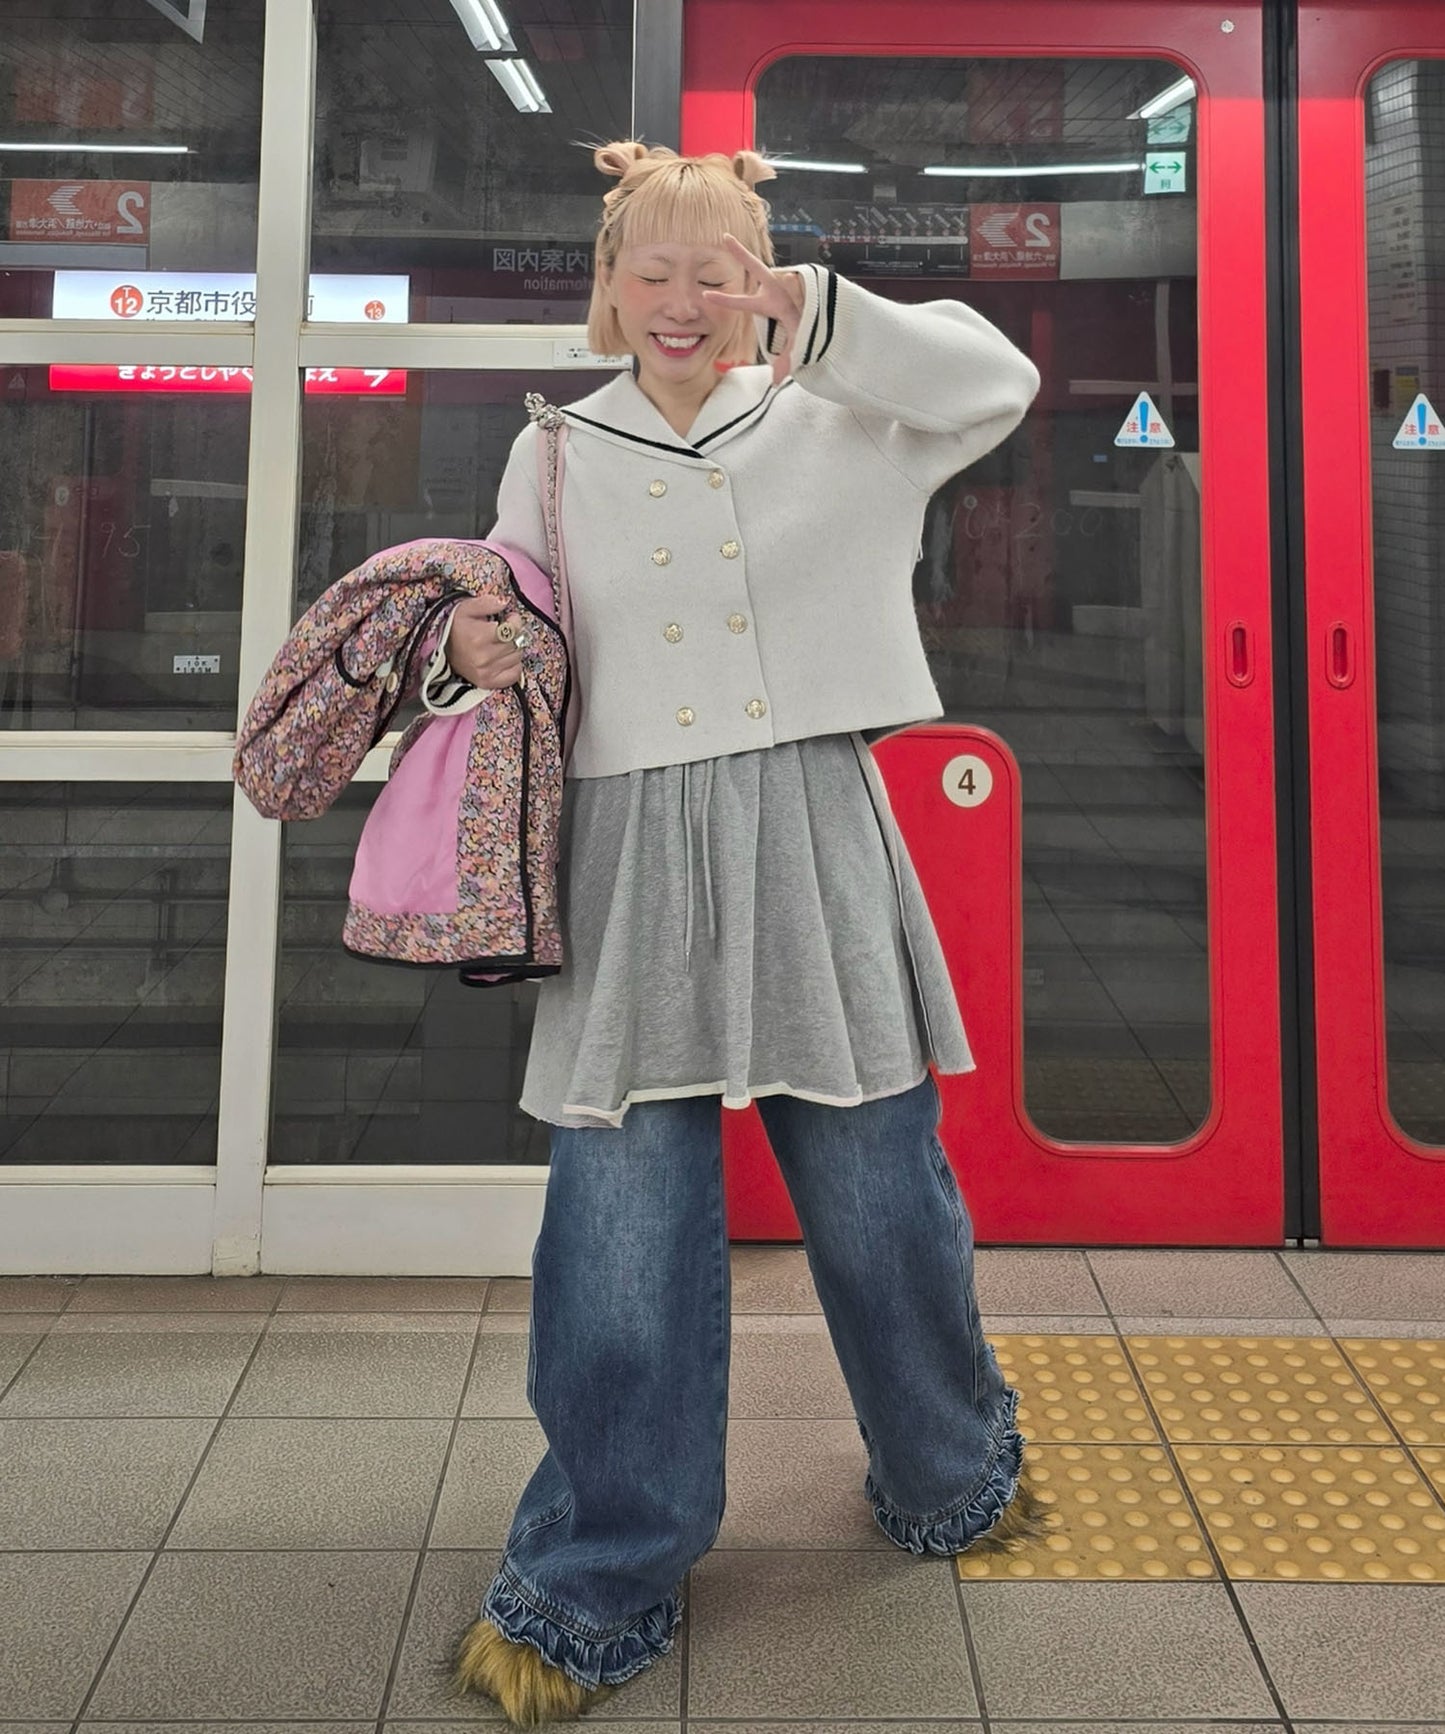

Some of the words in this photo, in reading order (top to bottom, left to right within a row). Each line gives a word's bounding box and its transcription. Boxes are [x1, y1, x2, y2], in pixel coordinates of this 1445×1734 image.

[115, 298, 137, 315] 12
[367, 309, 383, 319] 13
[957, 768, 976, 795] 4
